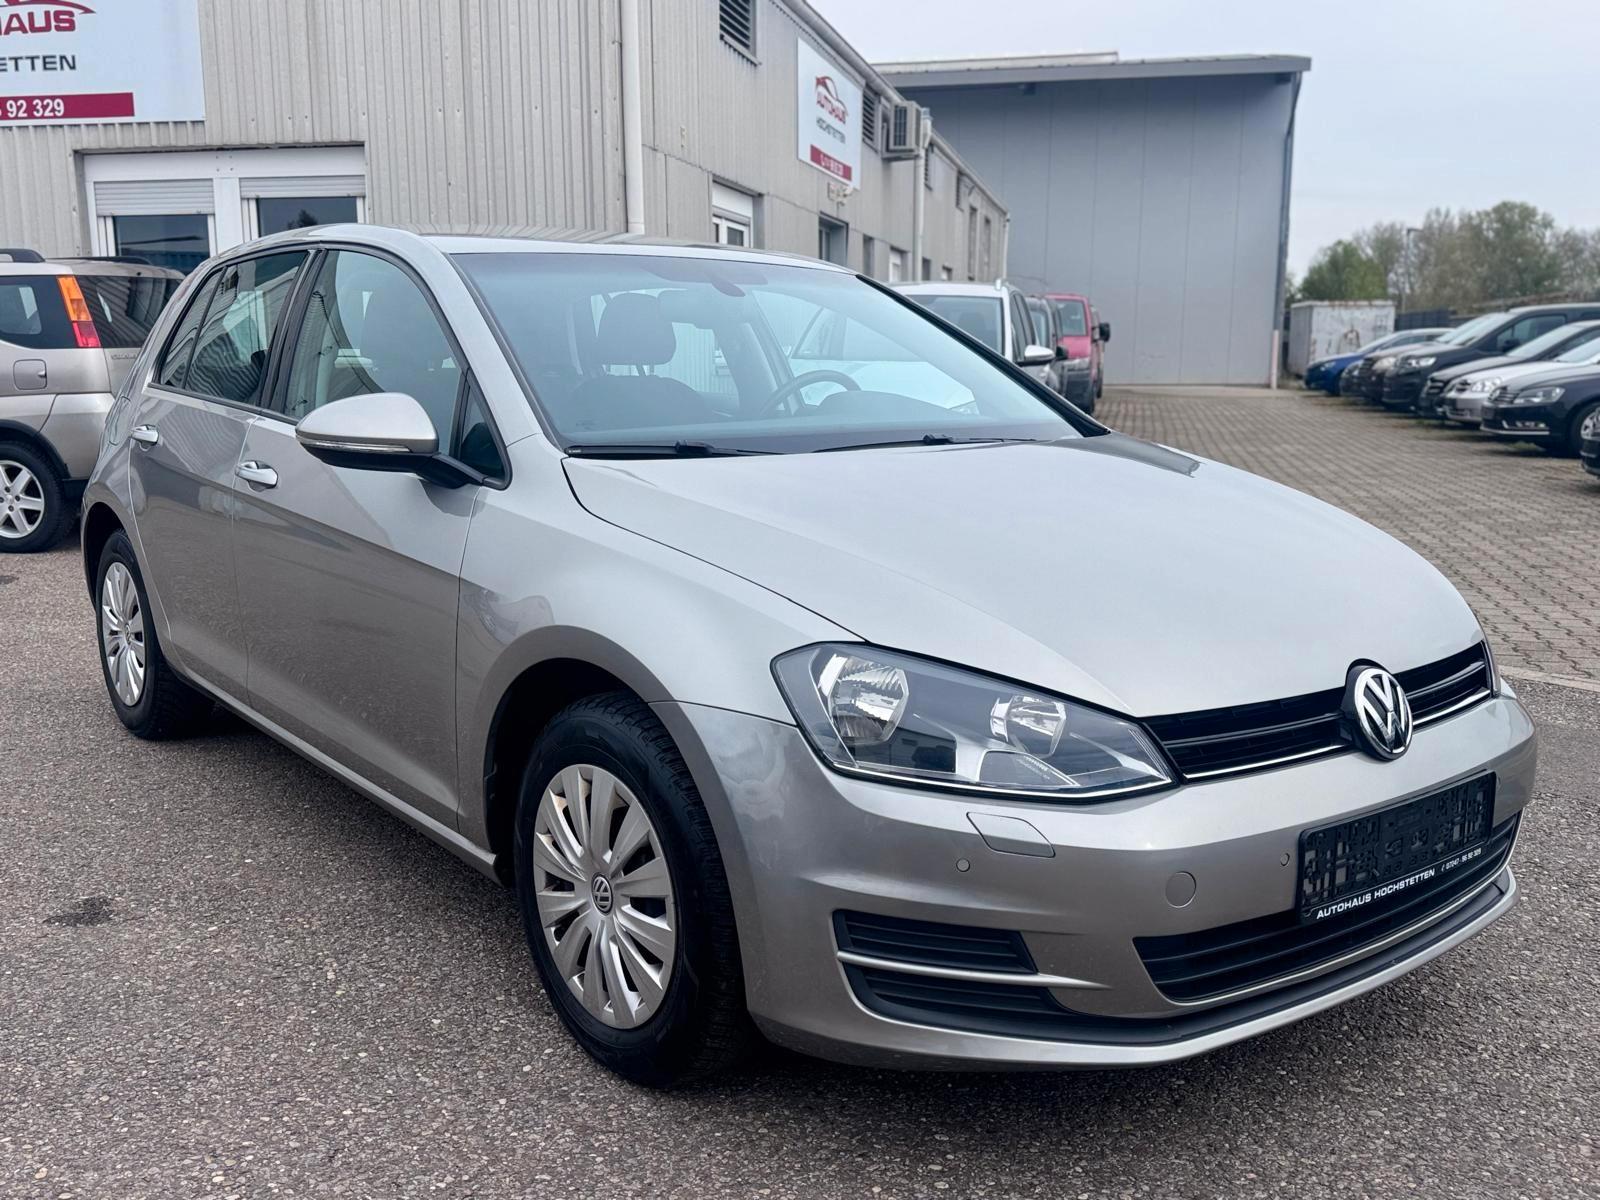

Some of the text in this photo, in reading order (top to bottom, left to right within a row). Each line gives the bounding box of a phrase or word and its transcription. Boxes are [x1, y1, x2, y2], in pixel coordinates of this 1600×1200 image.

[0, 10, 76, 36] AUS
[6, 98, 65, 118] 92 329
[1316, 893, 1372, 919] AUTOHAUS
[1374, 868, 1436, 899] HOCHSTETTEN
